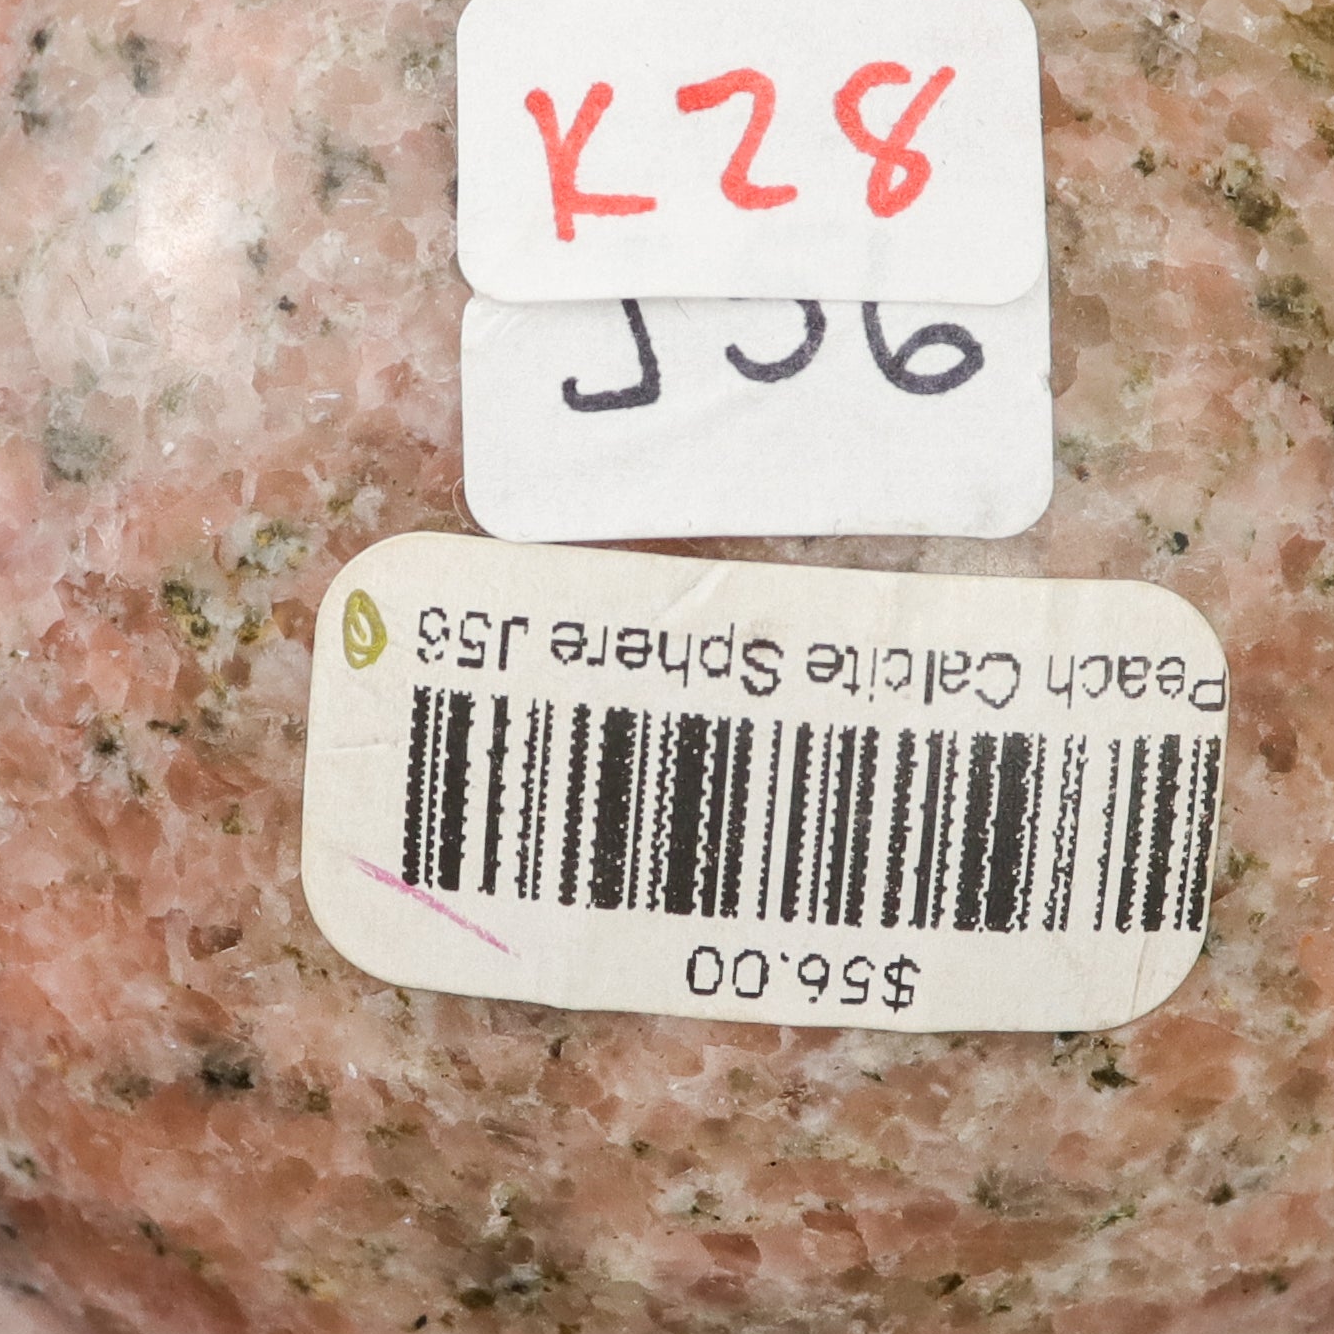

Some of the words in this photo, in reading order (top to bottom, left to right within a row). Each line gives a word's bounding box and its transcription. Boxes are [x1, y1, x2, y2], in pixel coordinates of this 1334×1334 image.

[525, 62, 956, 242] K28
[551, 622, 783, 696] Sphere
[807, 644, 1020, 709] Calcite
[1048, 656, 1225, 711] Peach
[686, 946, 920, 1012] $56.00
